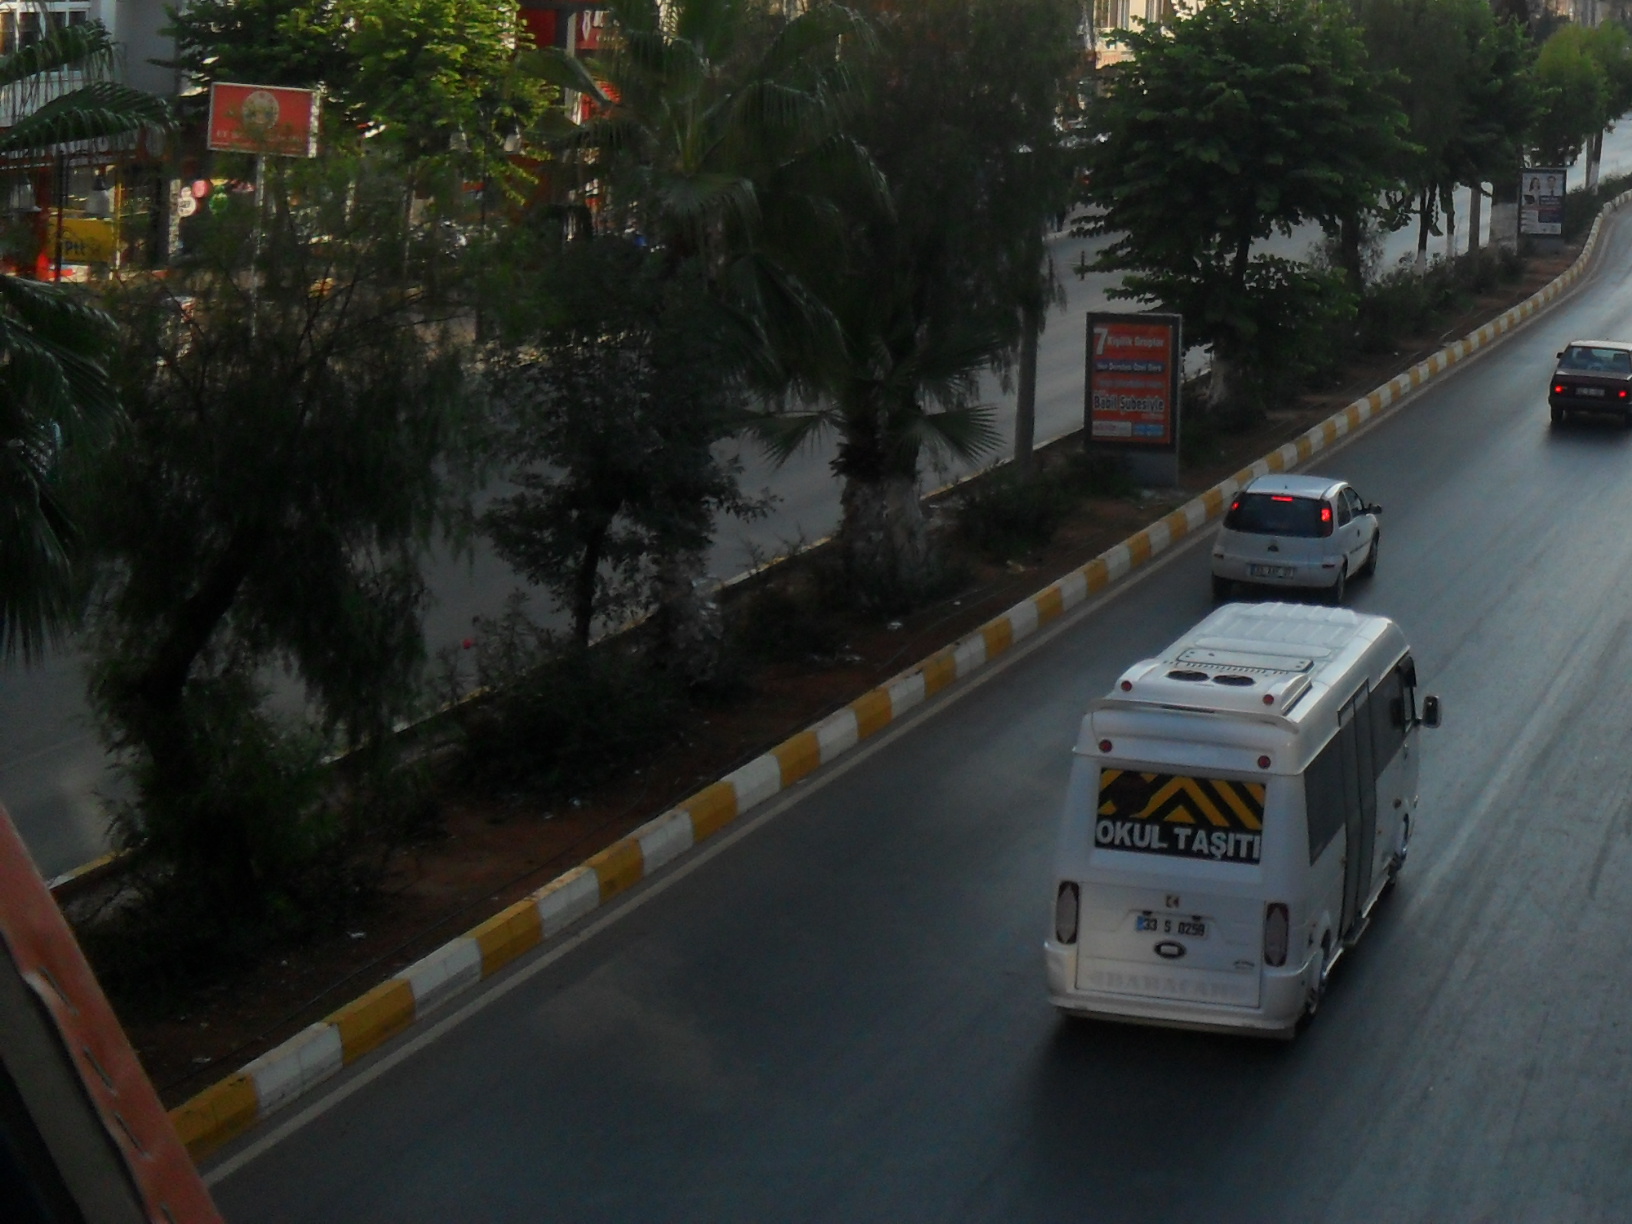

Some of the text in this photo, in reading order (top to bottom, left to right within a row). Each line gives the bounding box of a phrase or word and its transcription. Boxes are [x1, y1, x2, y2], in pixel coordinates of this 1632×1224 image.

[1093, 327, 1108, 355] 7
[1095, 820, 1262, 860] OKUL TAŞITI
